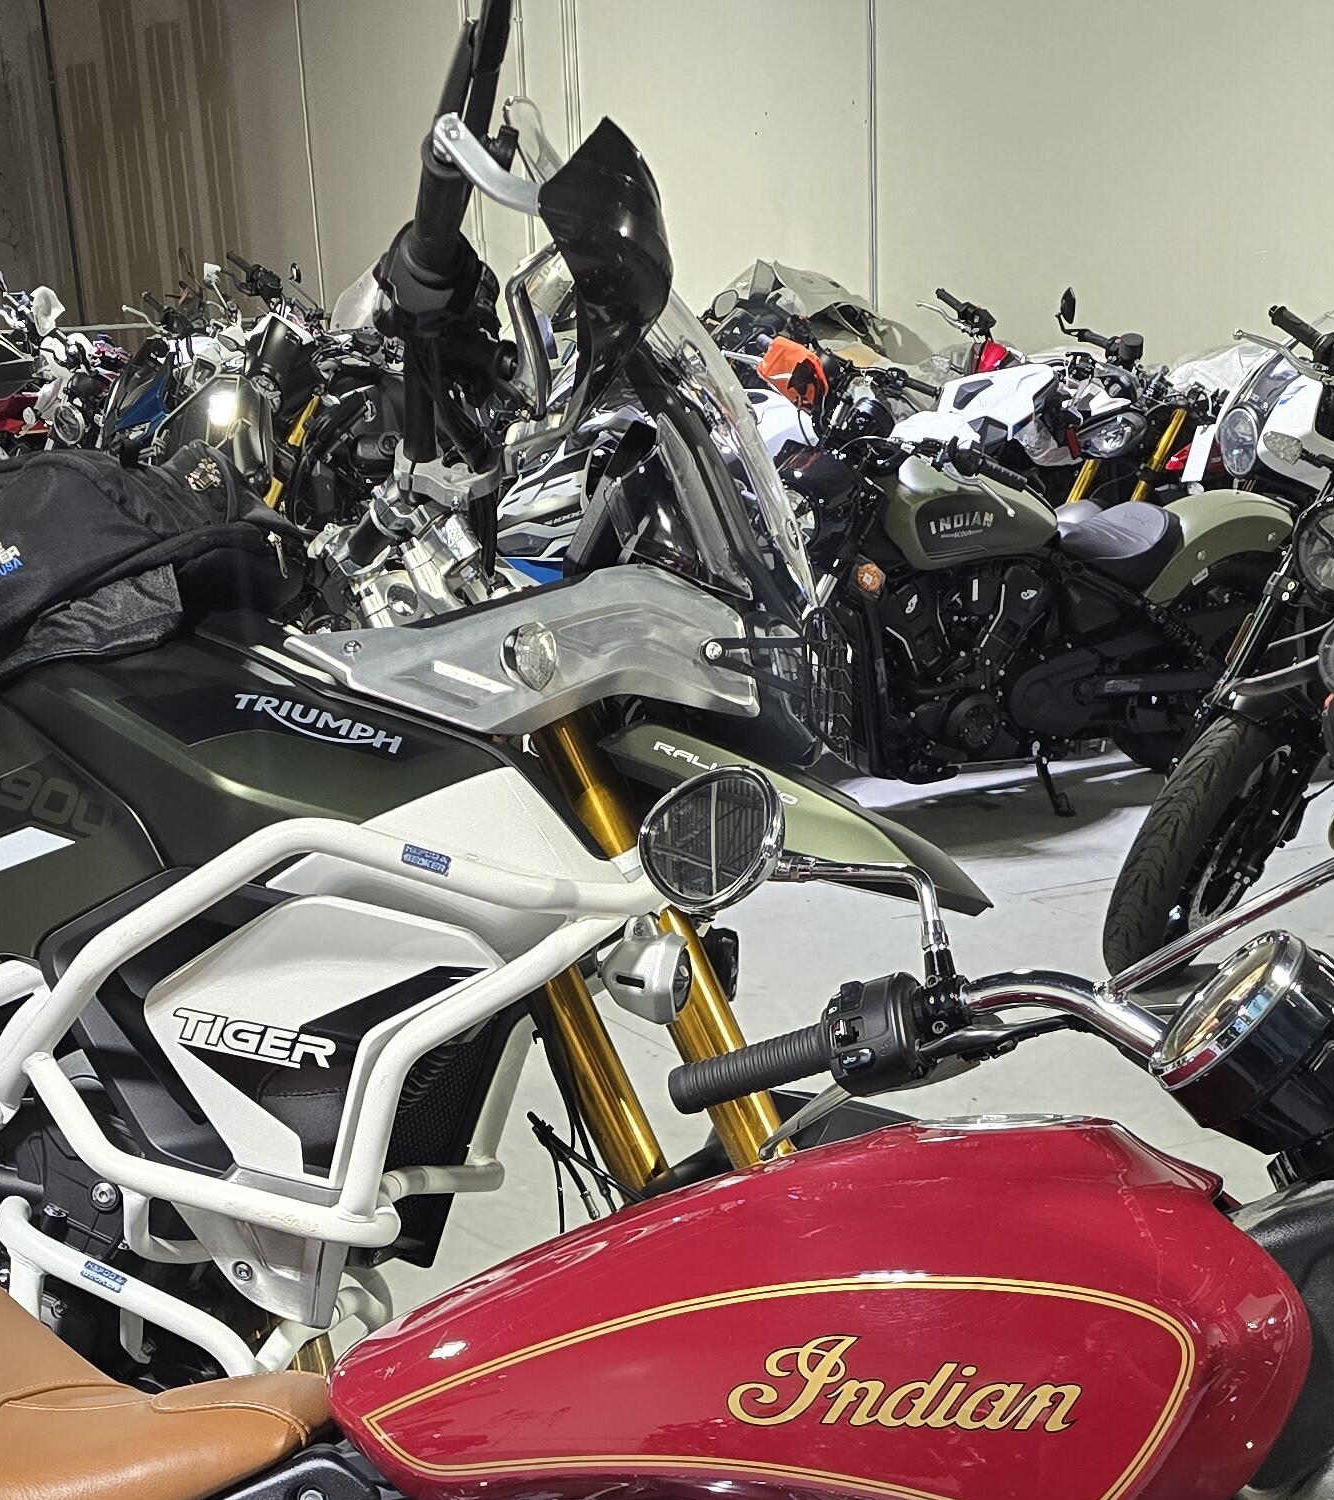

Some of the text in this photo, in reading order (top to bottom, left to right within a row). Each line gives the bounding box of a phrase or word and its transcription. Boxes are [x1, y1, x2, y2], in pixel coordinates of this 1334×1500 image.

[929, 511, 995, 535] INDIAN
[234, 693, 403, 754] TRIUMPH
[172, 1007, 337, 1069] TIGER
[726, 1333, 1084, 1433] Indian
